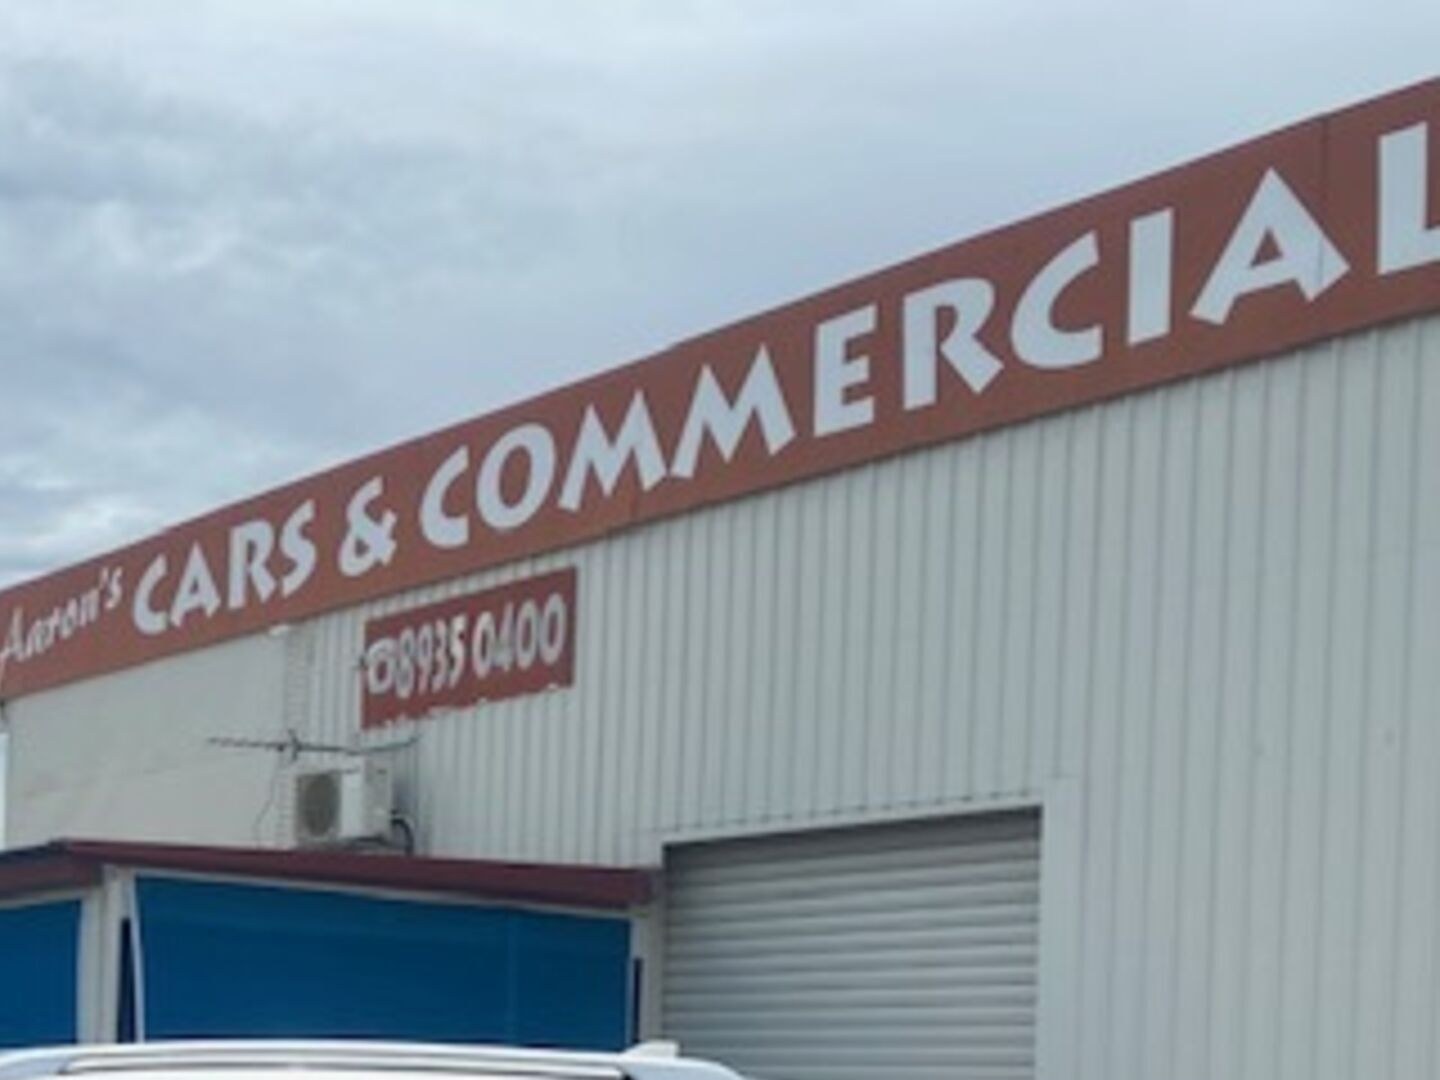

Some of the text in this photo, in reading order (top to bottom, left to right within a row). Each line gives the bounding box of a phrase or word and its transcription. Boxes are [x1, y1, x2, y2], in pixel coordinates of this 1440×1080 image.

[132, 501, 317, 635] CARS
[338, 477, 398, 577] &
[394, 592, 568, 699] 8935 0400
